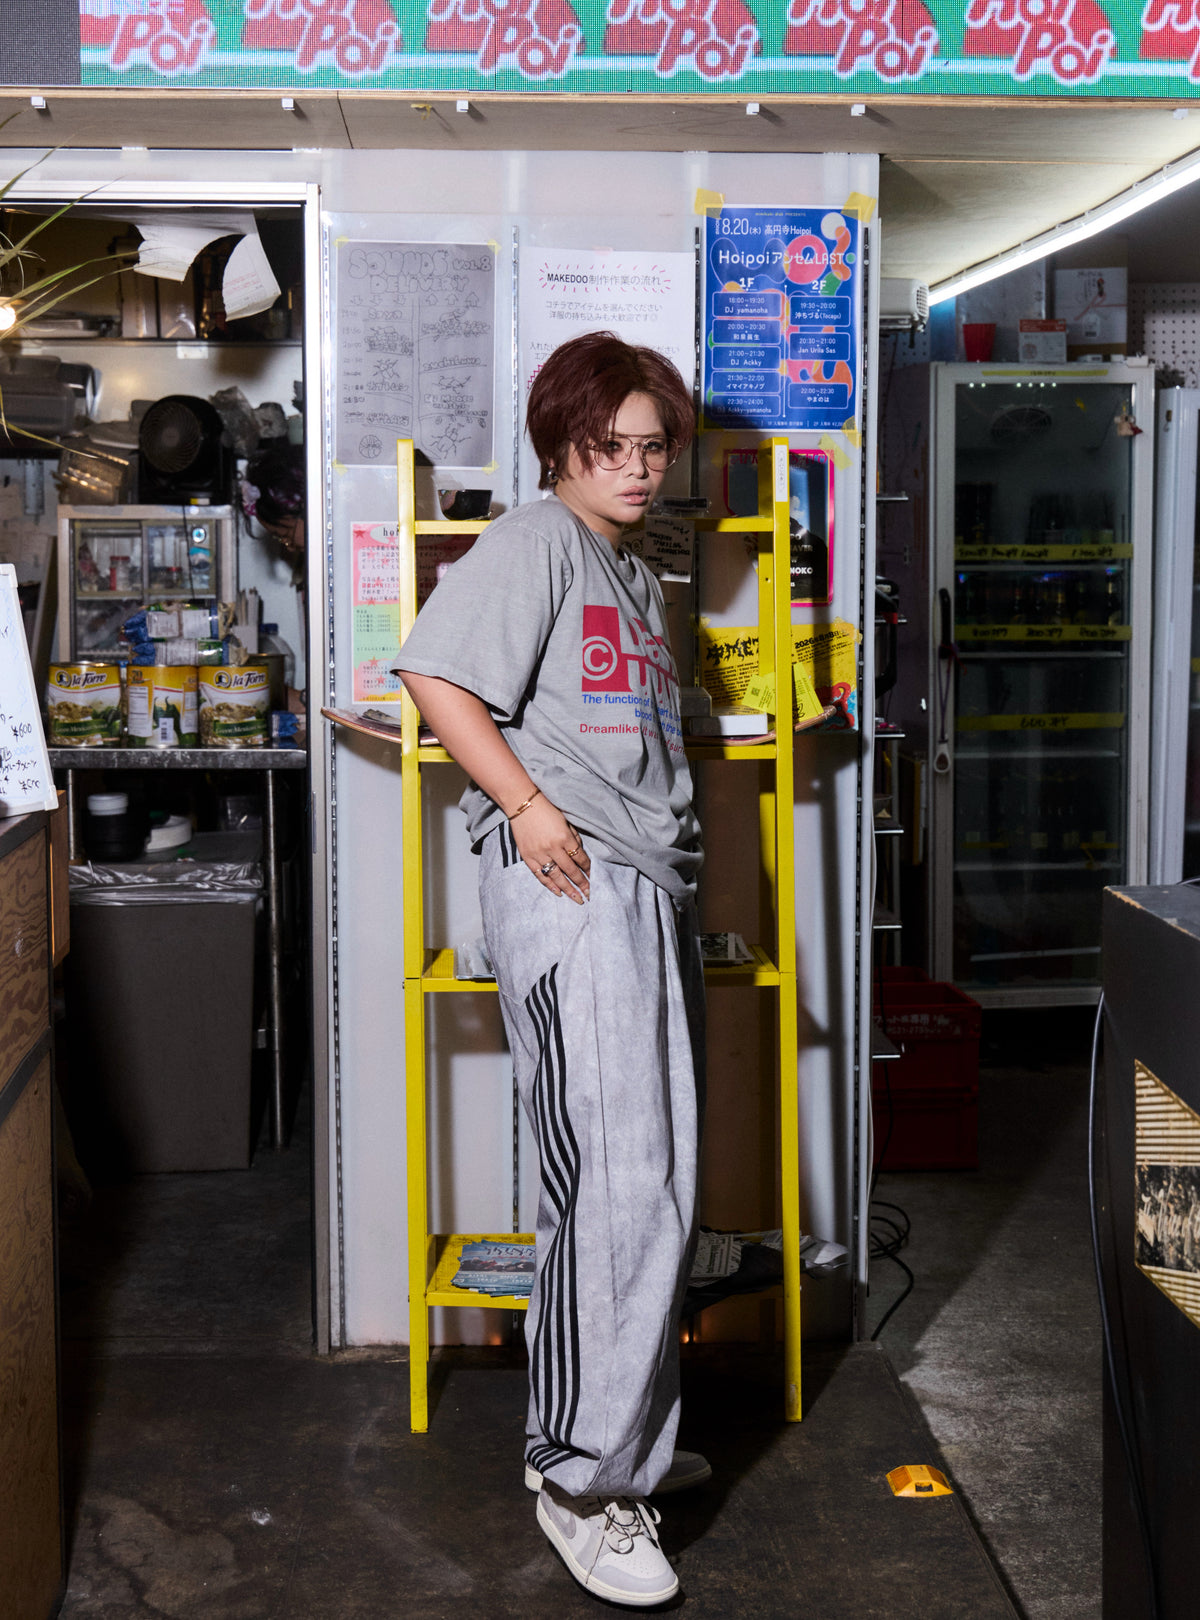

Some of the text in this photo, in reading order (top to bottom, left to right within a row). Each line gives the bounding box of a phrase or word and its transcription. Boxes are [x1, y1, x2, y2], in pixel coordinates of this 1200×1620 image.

[739, 277, 754, 288] 1F
[811, 280, 826, 291] 2F
[82, 672, 107, 687] Torre
[582, 694, 602, 705] The
[604, 694, 643, 706] function
[579, 723, 640, 734] Dreamlike
